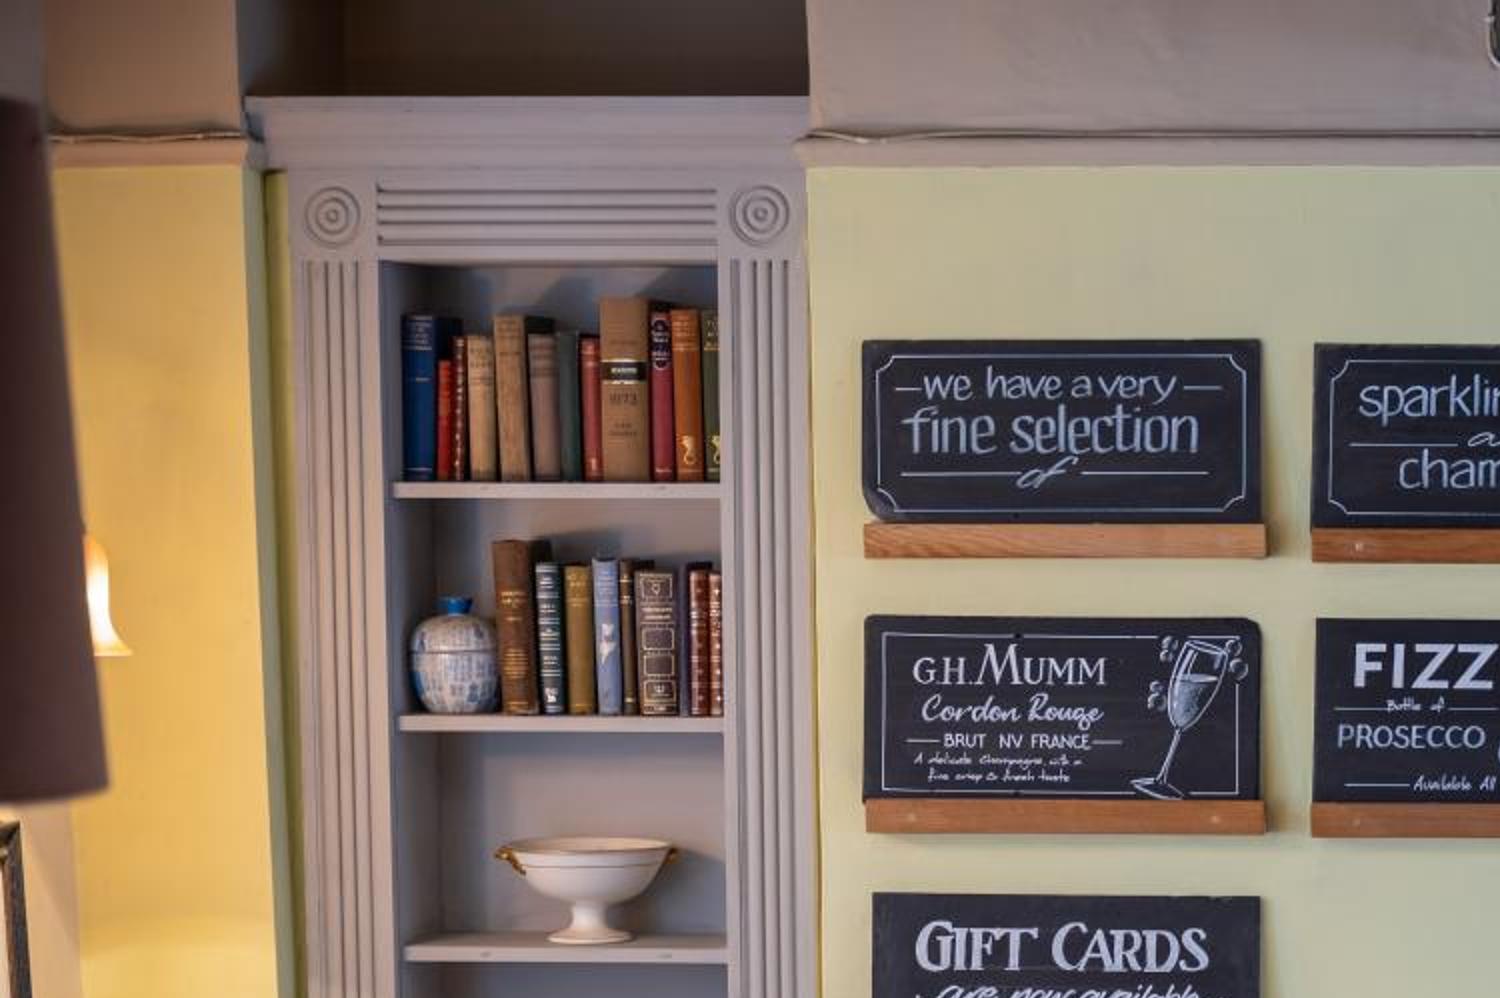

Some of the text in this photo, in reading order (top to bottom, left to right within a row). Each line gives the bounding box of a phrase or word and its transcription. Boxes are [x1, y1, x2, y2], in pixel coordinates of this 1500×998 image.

[923, 365, 1177, 404] we have a very
[902, 403, 1199, 454] fine selection
[1016, 456, 1079, 488] of
[1353, 643, 1499, 689] FIZZ
[921, 694, 1104, 731] Cordon Rouge
[943, 734, 1092, 750] BRUT NV FRANCE
[1338, 723, 1486, 749] PROSECCO
[1413, 775, 1473, 792] Available
[915, 920, 1209, 973] GIFT CARDS
